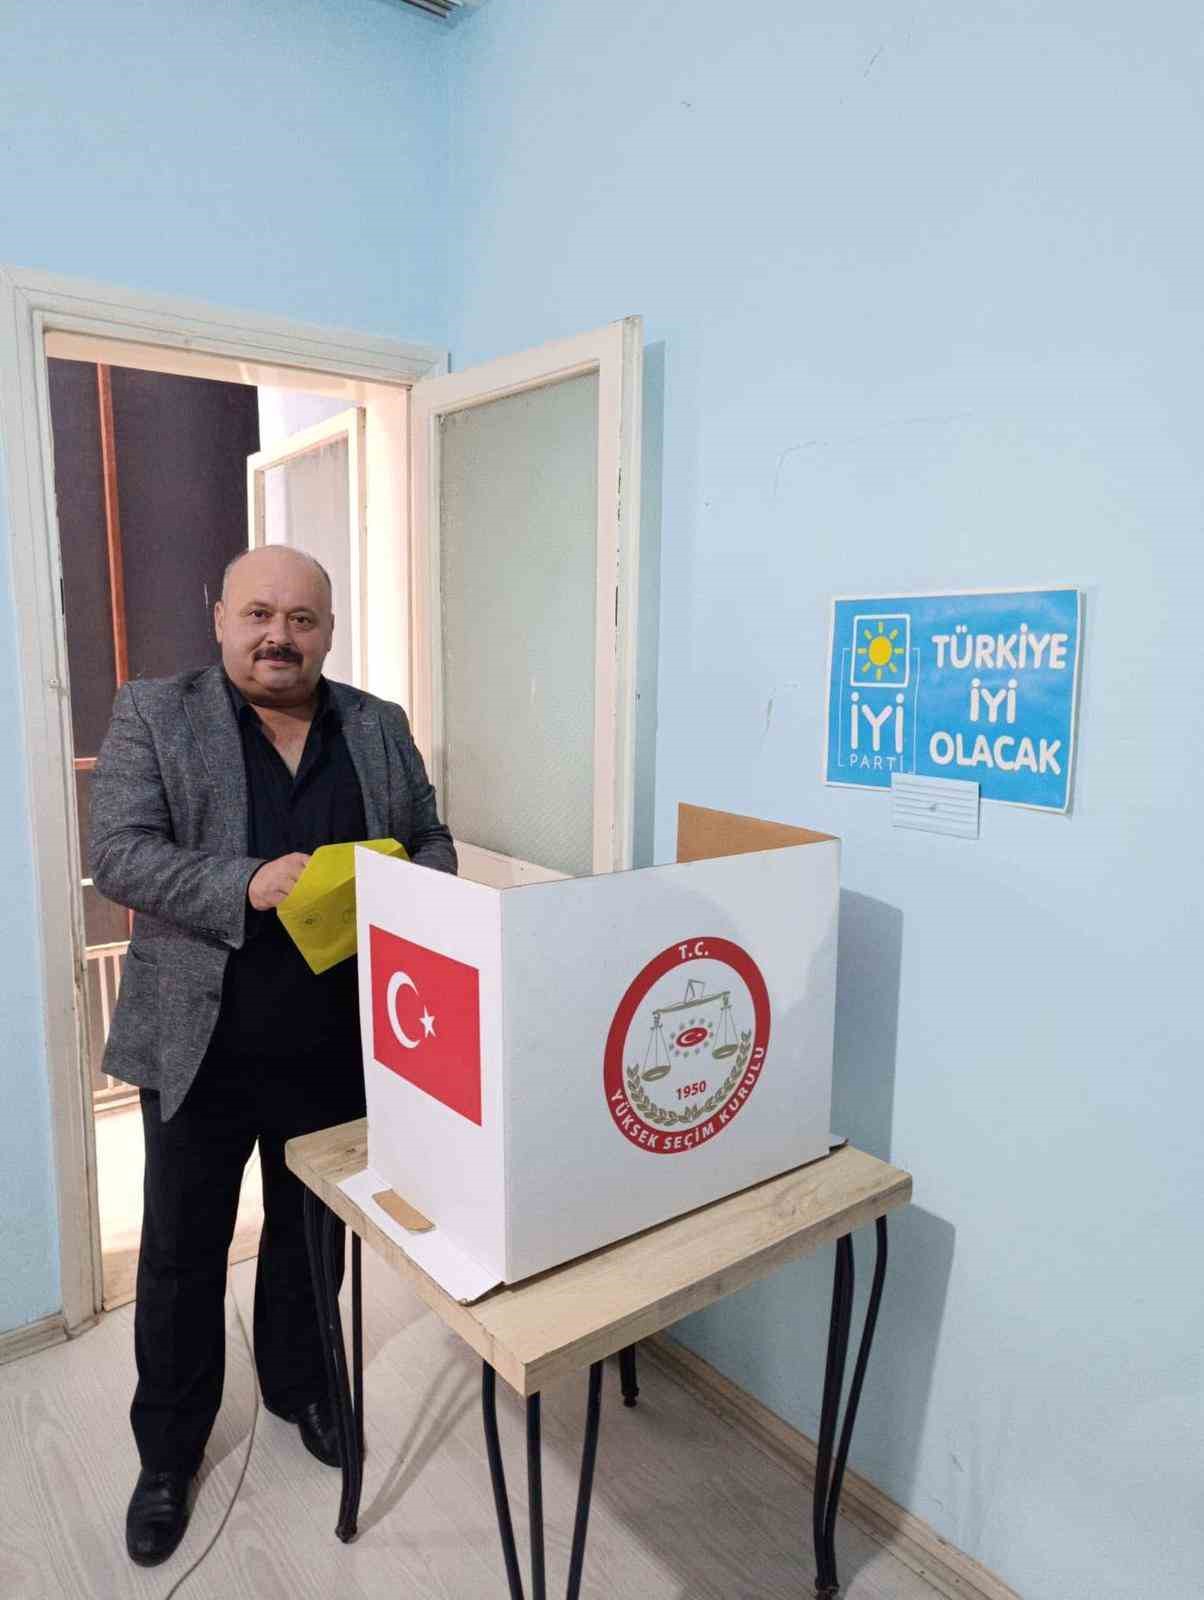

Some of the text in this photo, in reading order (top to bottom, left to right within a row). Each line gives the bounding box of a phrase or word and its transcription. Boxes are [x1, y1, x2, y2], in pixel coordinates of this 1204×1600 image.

[931, 623, 1068, 670] TÜRKİYE
[850, 691, 904, 753] İYİ
[969, 678, 1018, 724] İYİ
[928, 731, 1062, 776] OLACAK
[678, 942, 709, 960] T.C.
[610, 1047, 765, 1151] YÜKSEK SEÇİM KURULU
[676, 1080, 707, 1101] 1950
